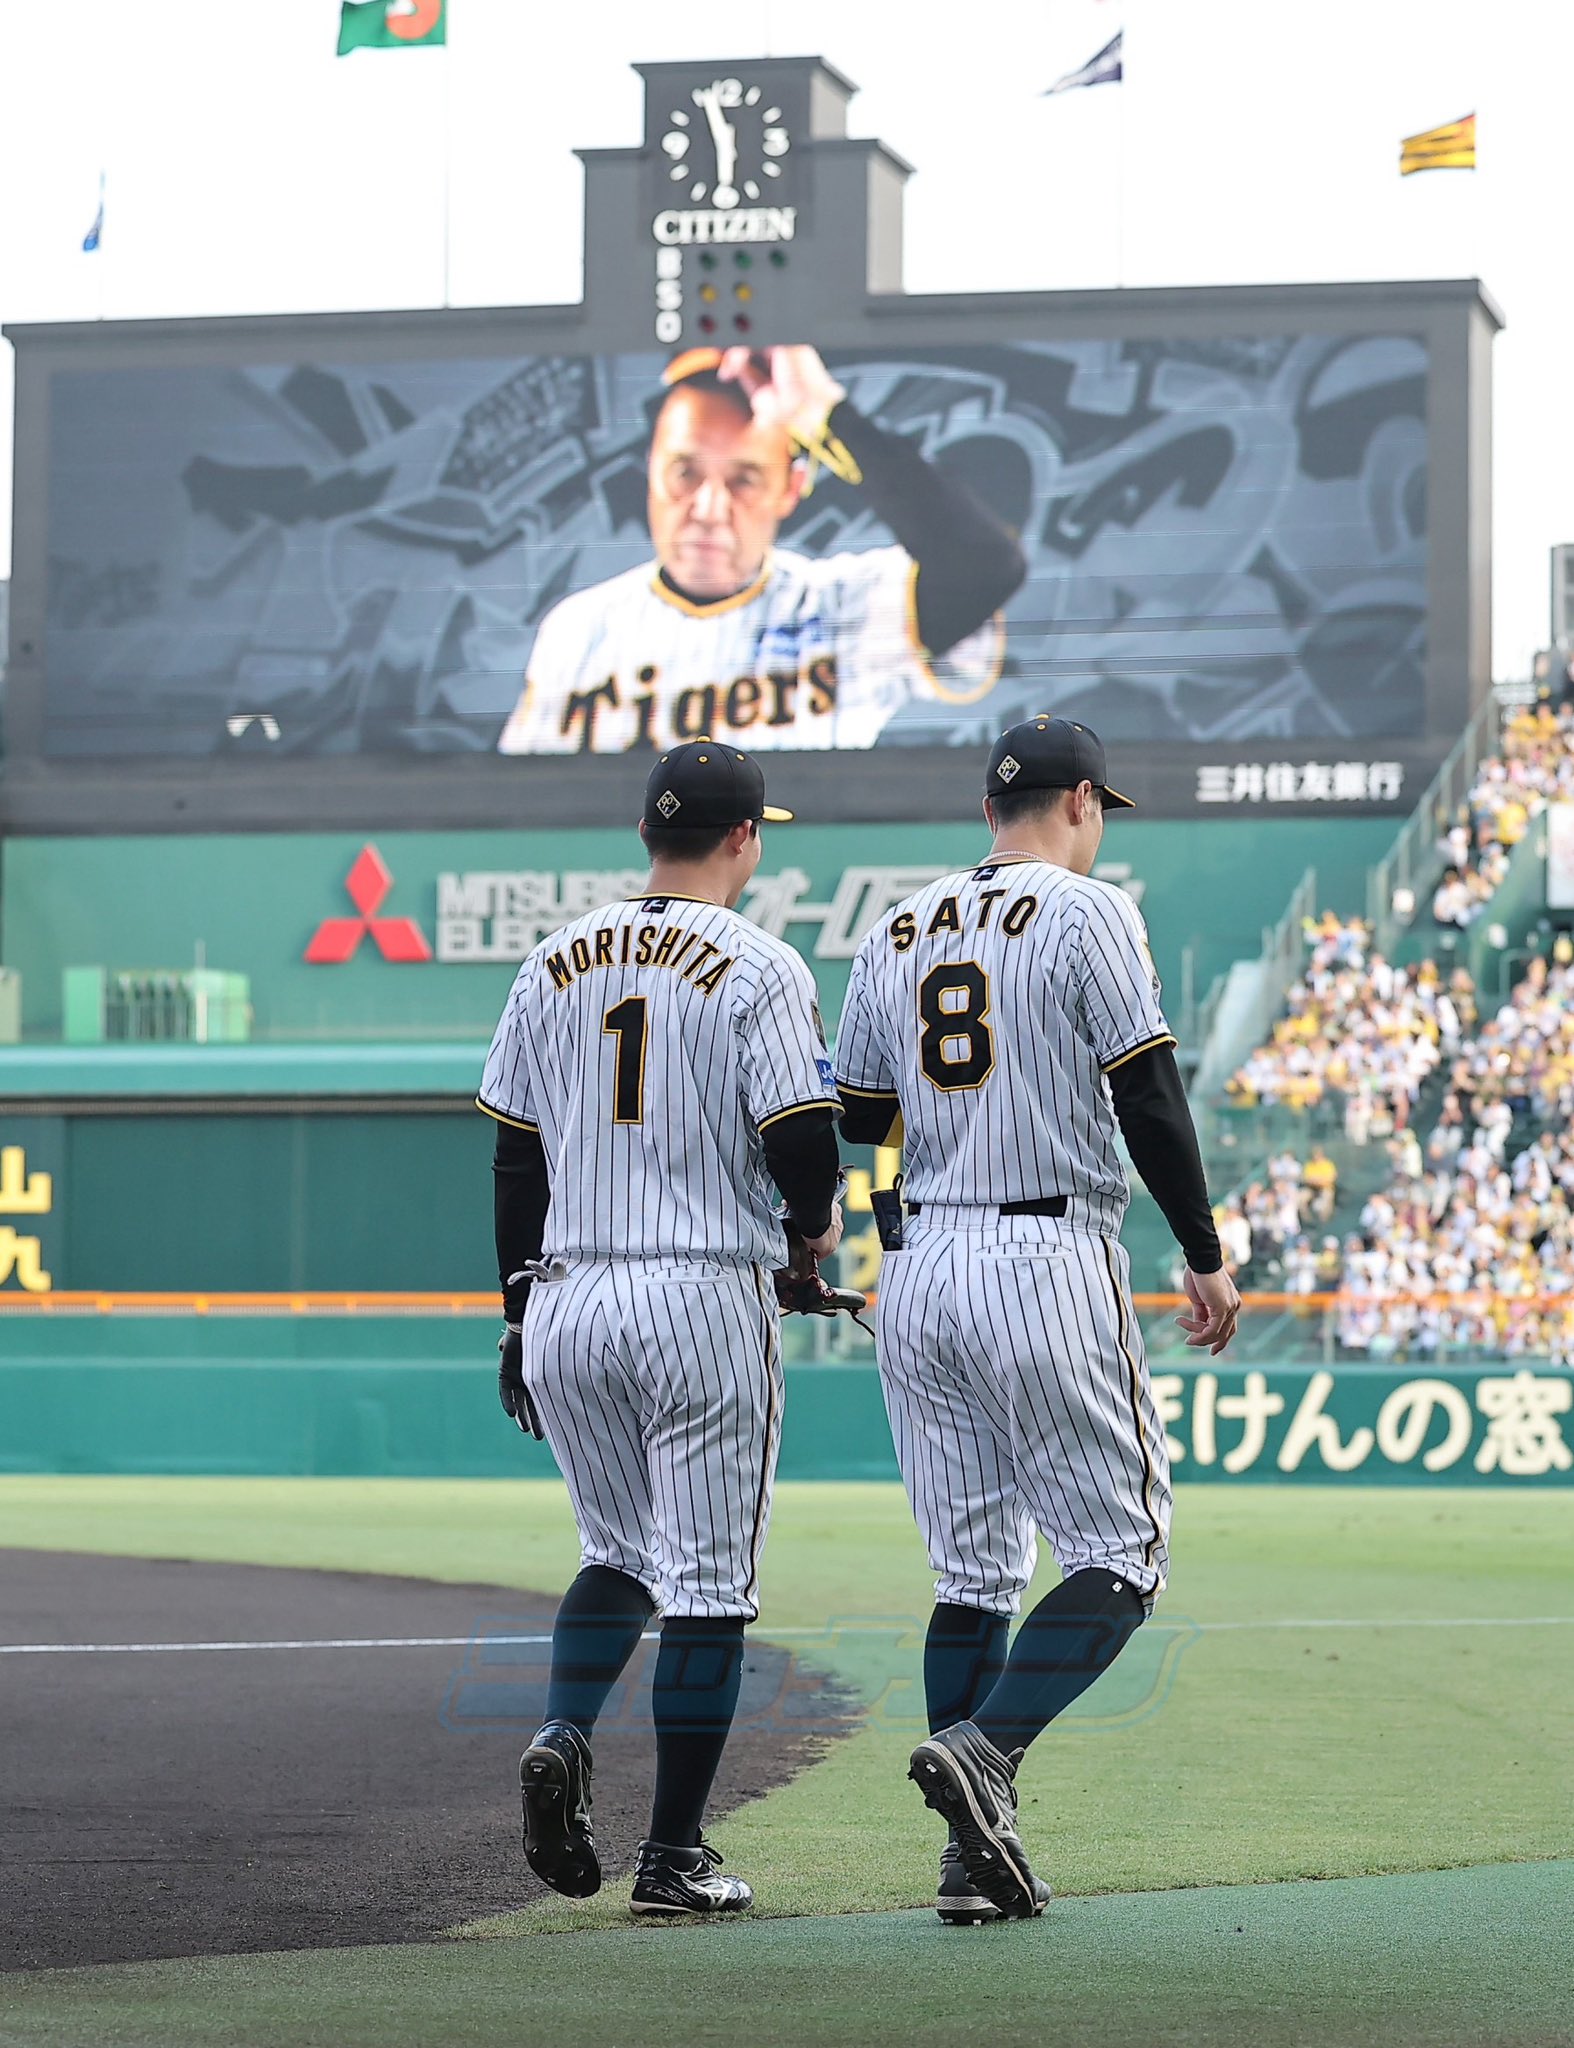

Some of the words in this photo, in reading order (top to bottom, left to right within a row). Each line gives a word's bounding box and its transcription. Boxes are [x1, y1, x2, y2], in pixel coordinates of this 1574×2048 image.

[652, 206, 797, 245] CITIZEN
[560, 655, 838, 753] Tigers
[545, 924, 735, 999] MORISHITA
[889, 888, 1039, 954] SATO
[602, 994, 649, 1125] 1
[919, 959, 997, 1093] 8
